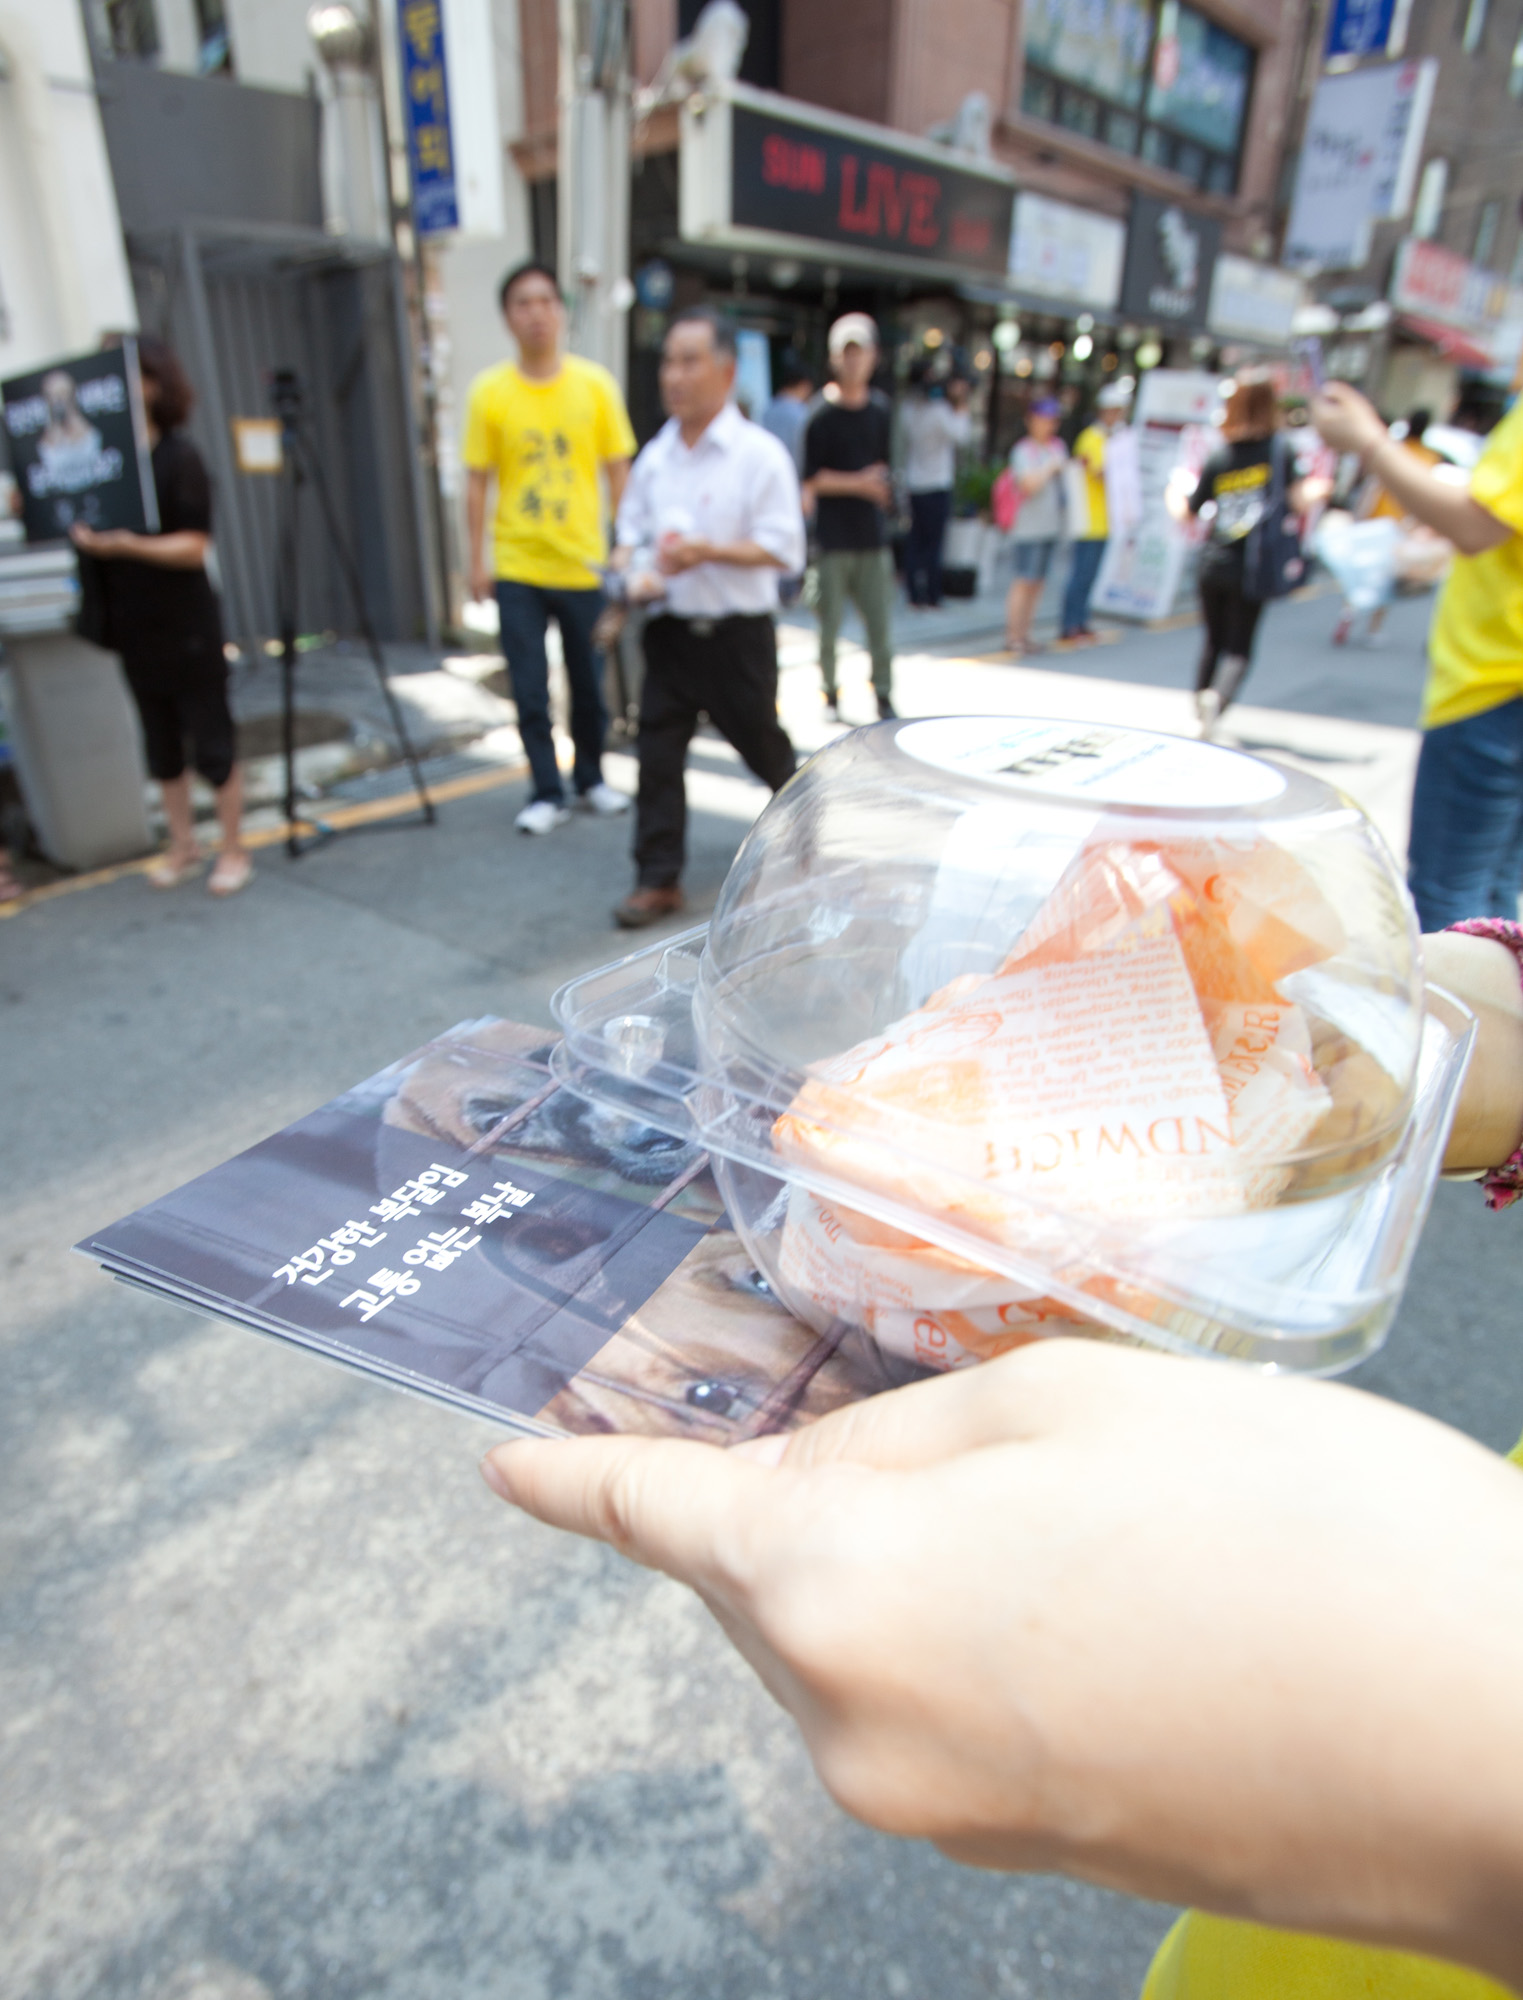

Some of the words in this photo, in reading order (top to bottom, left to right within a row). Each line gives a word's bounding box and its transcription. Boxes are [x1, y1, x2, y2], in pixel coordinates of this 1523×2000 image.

[838, 154, 942, 247] LIVE
[272, 1219, 388, 1286] 건강한
[368, 1162, 470, 1222] 복달임
[338, 1267, 421, 1322] 고통
[402, 1225, 483, 1272] 없는
[460, 1181, 536, 1225] 복날
